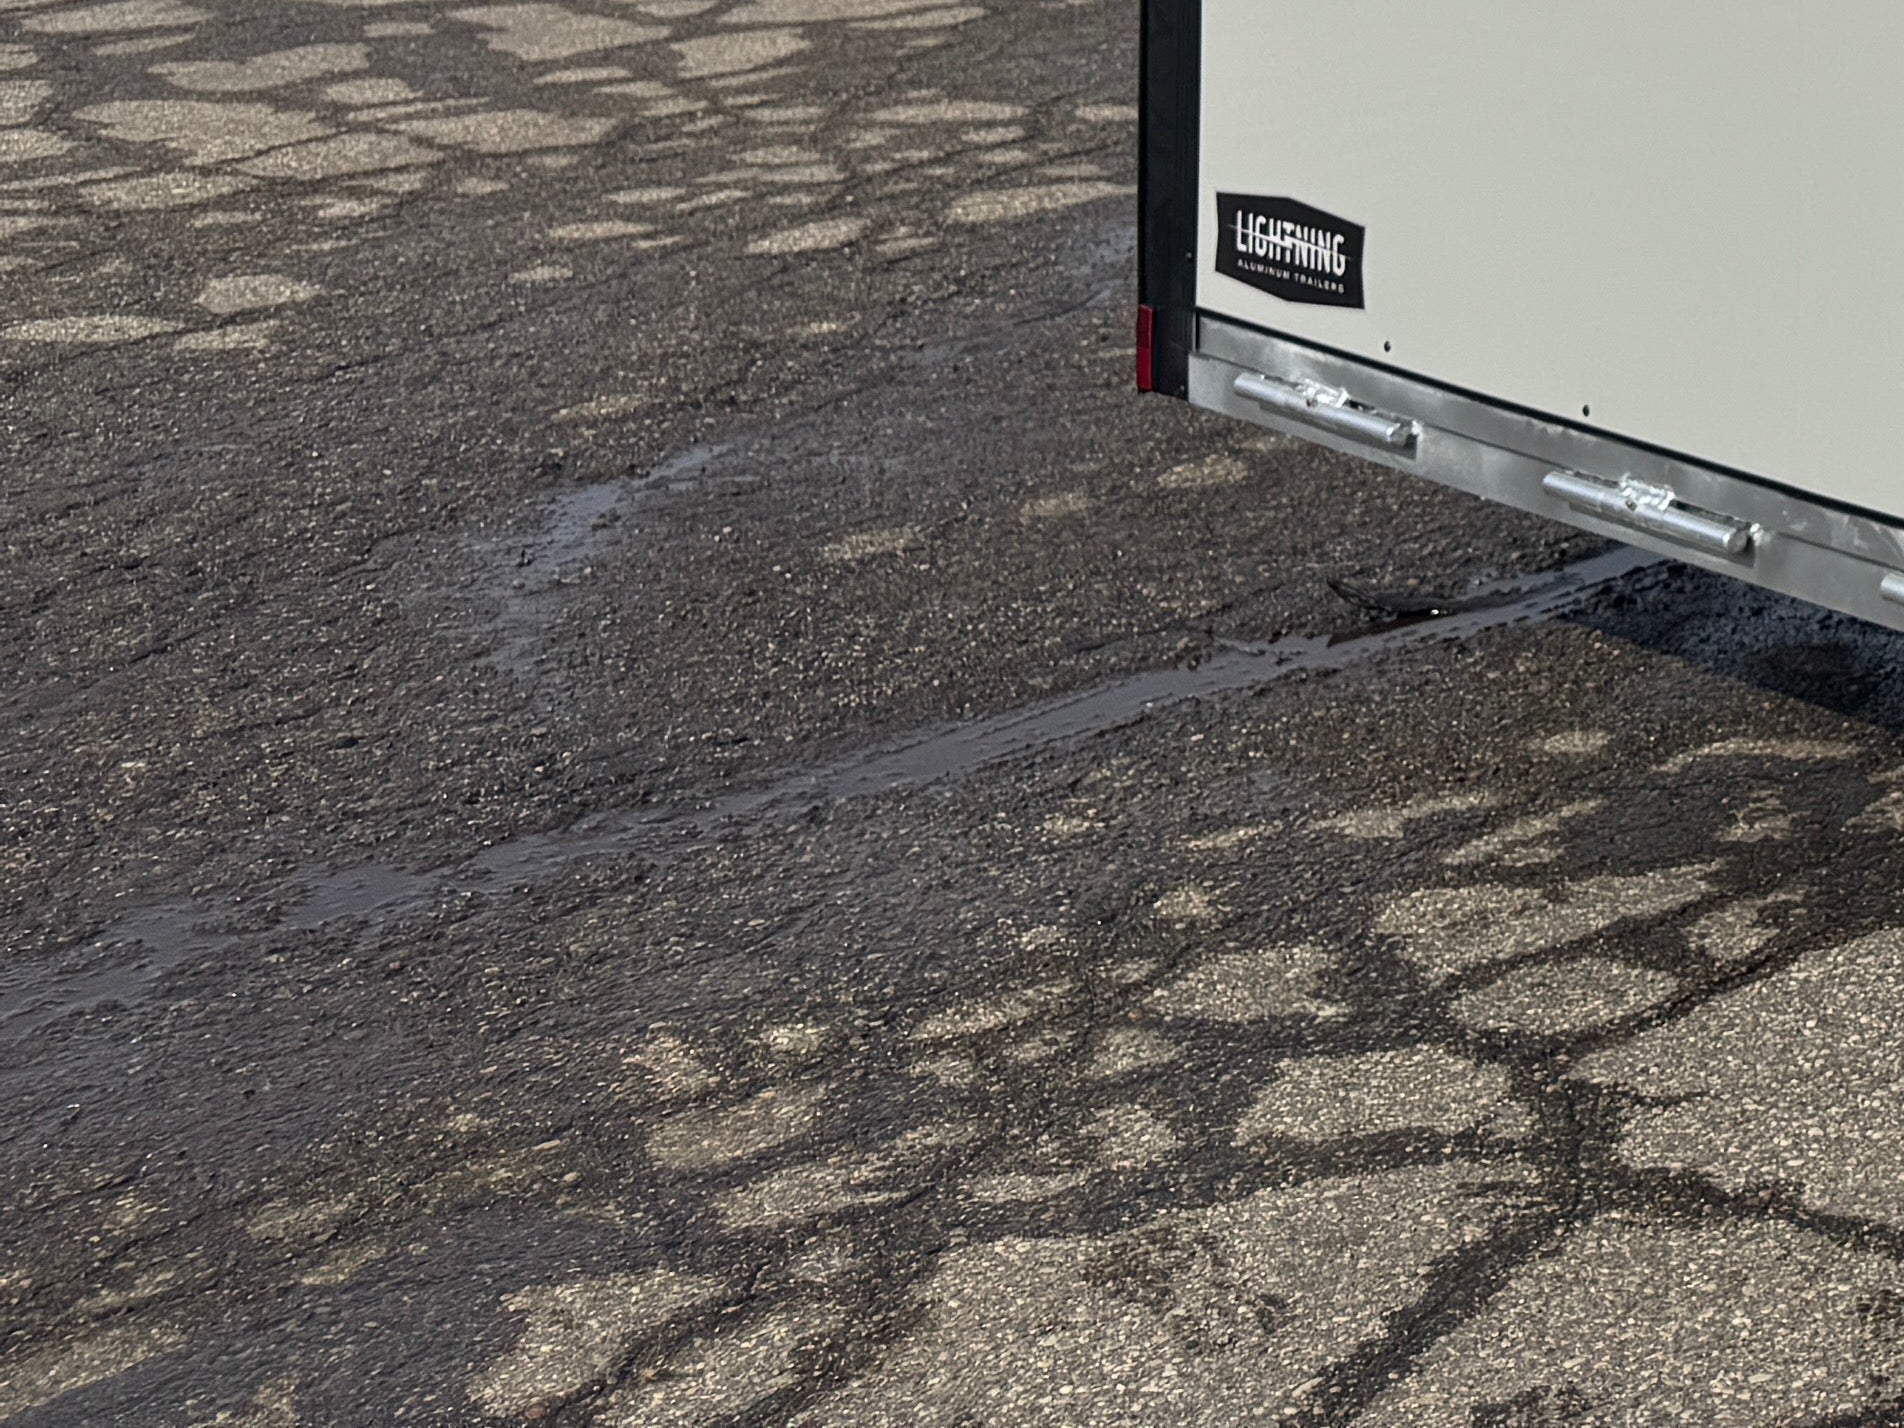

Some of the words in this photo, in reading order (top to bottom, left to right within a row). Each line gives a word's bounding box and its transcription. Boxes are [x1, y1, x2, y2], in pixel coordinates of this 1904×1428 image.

[1236, 210, 1346, 277] LIGHTNING
[1237, 259, 1290, 280] ALUMINUM
[1294, 272, 1345, 294] TRAILERS
